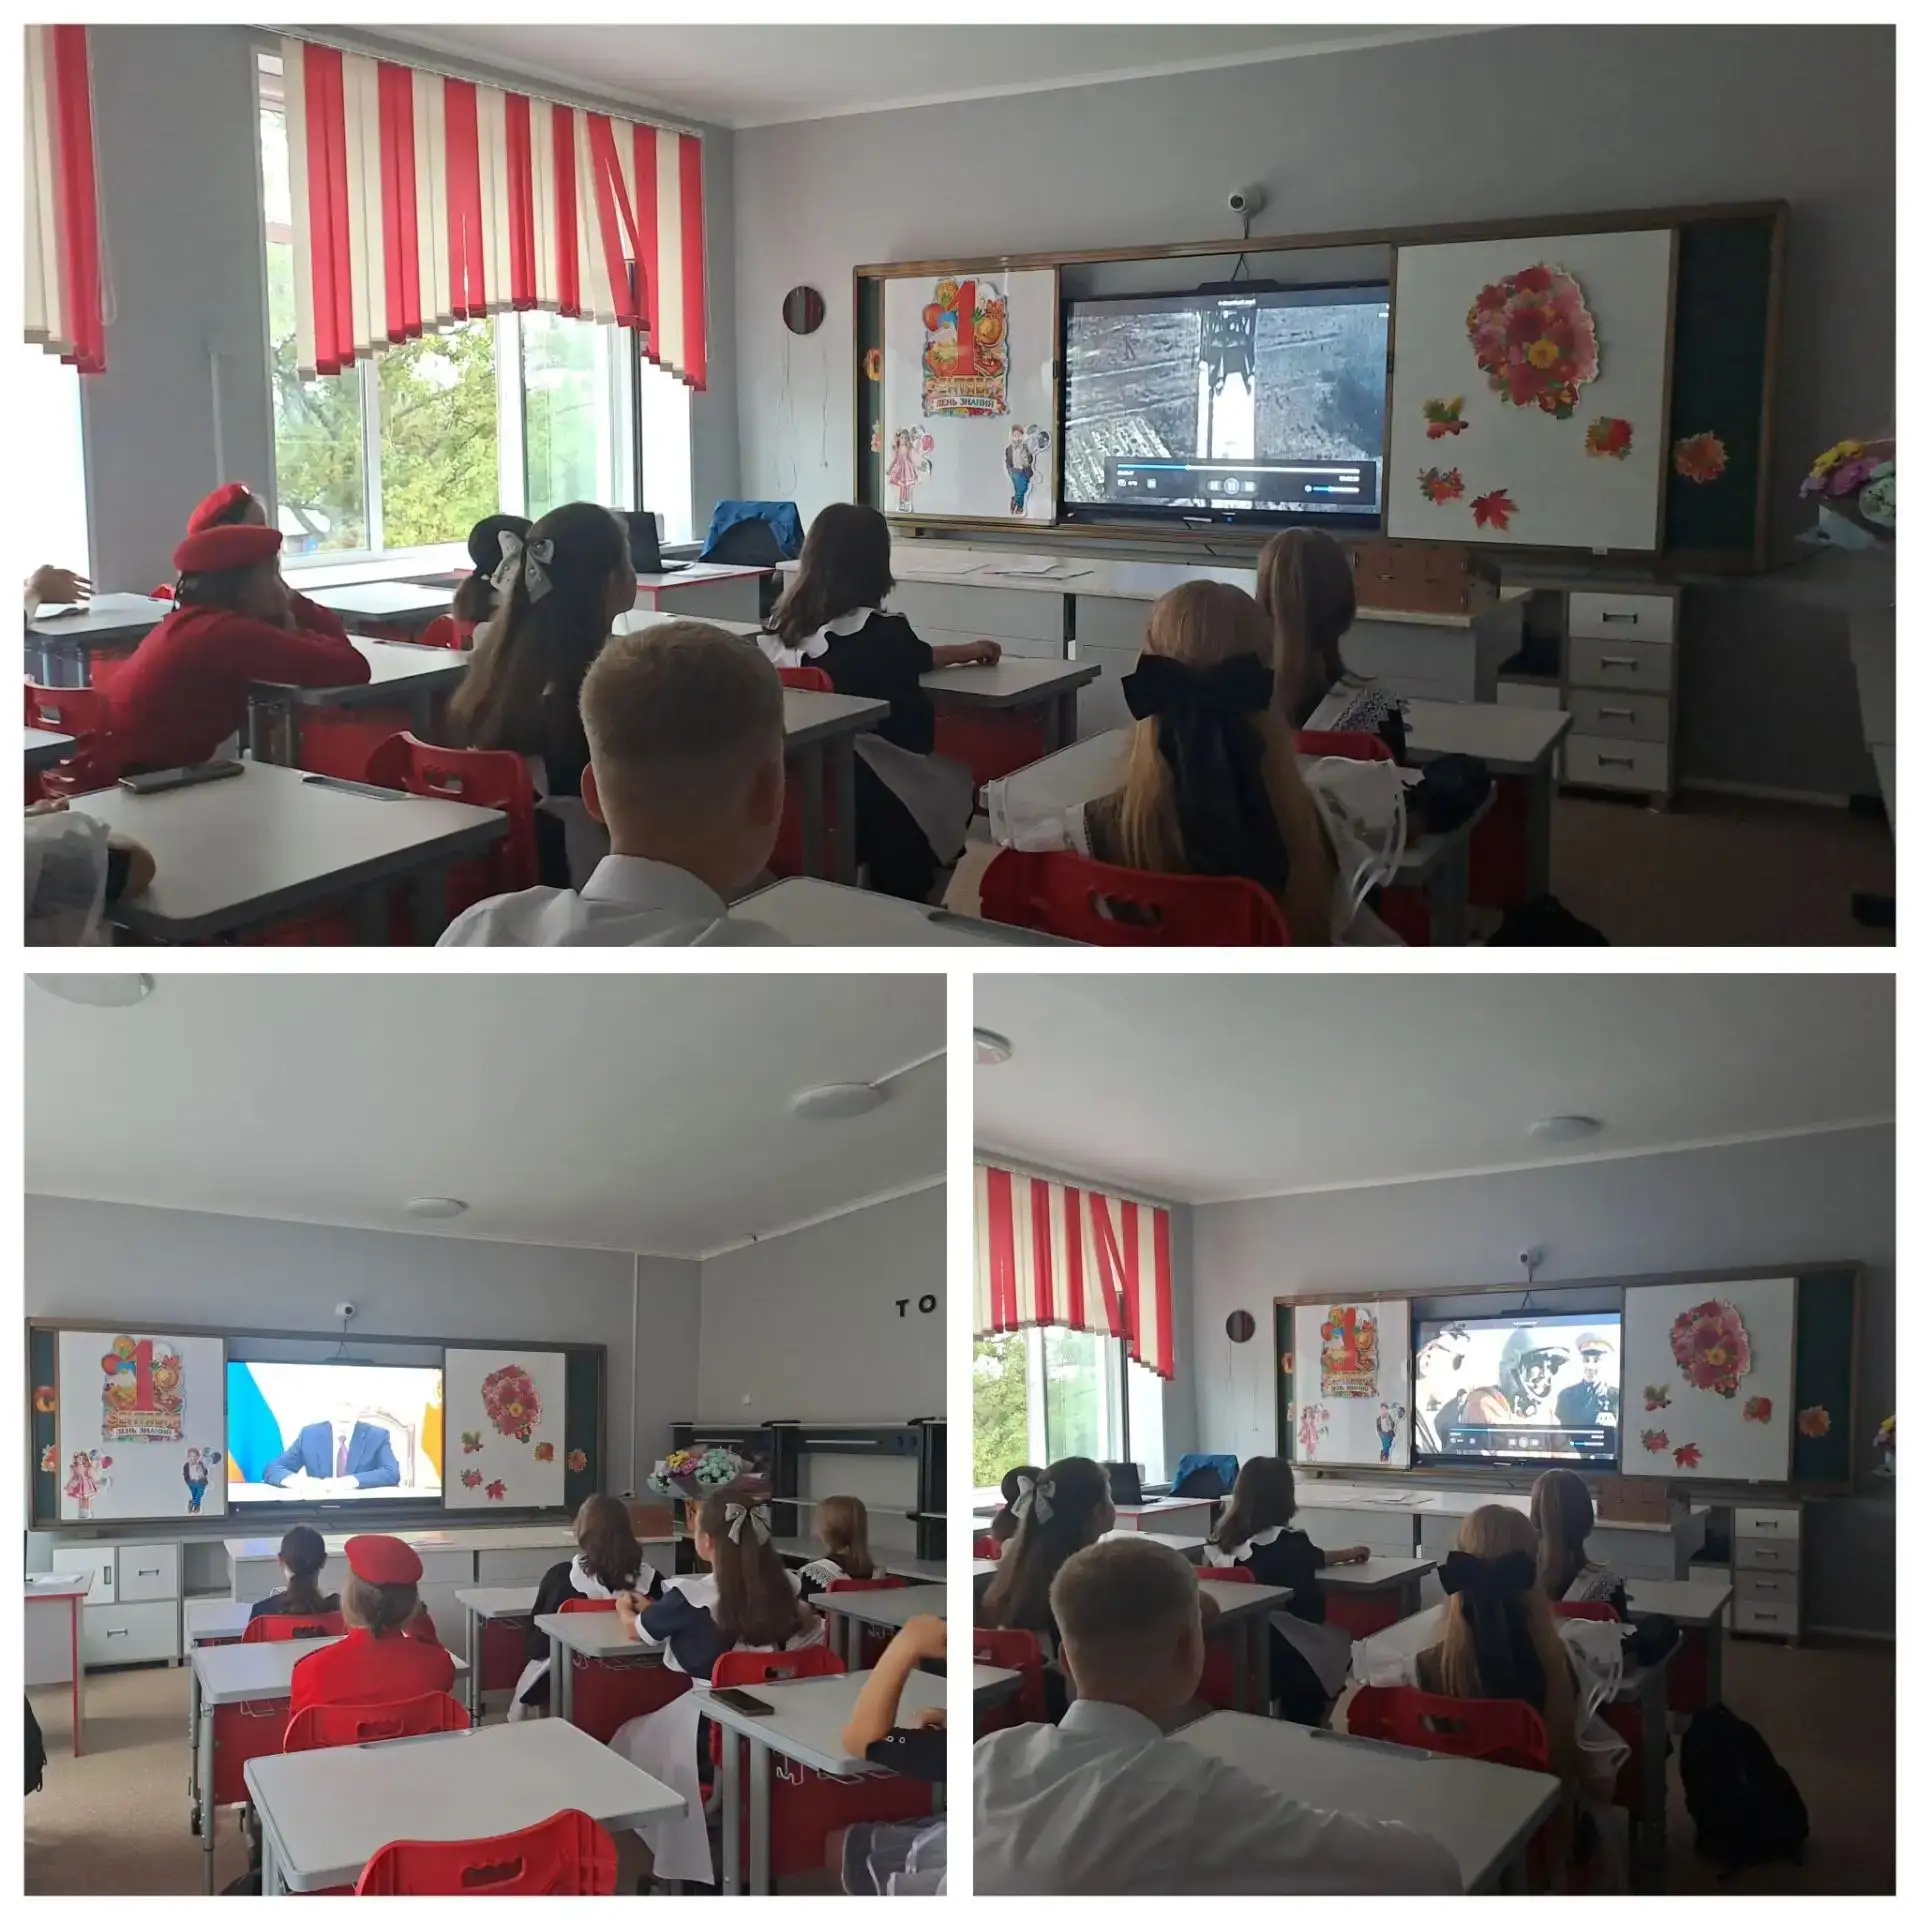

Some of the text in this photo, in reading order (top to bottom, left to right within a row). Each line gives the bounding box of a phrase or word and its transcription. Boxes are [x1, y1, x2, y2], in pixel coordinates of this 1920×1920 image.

[946, 280, 979, 376] 1
[936, 398, 957, 408] ДЕНЬ
[127, 1339, 160, 1412] 1
